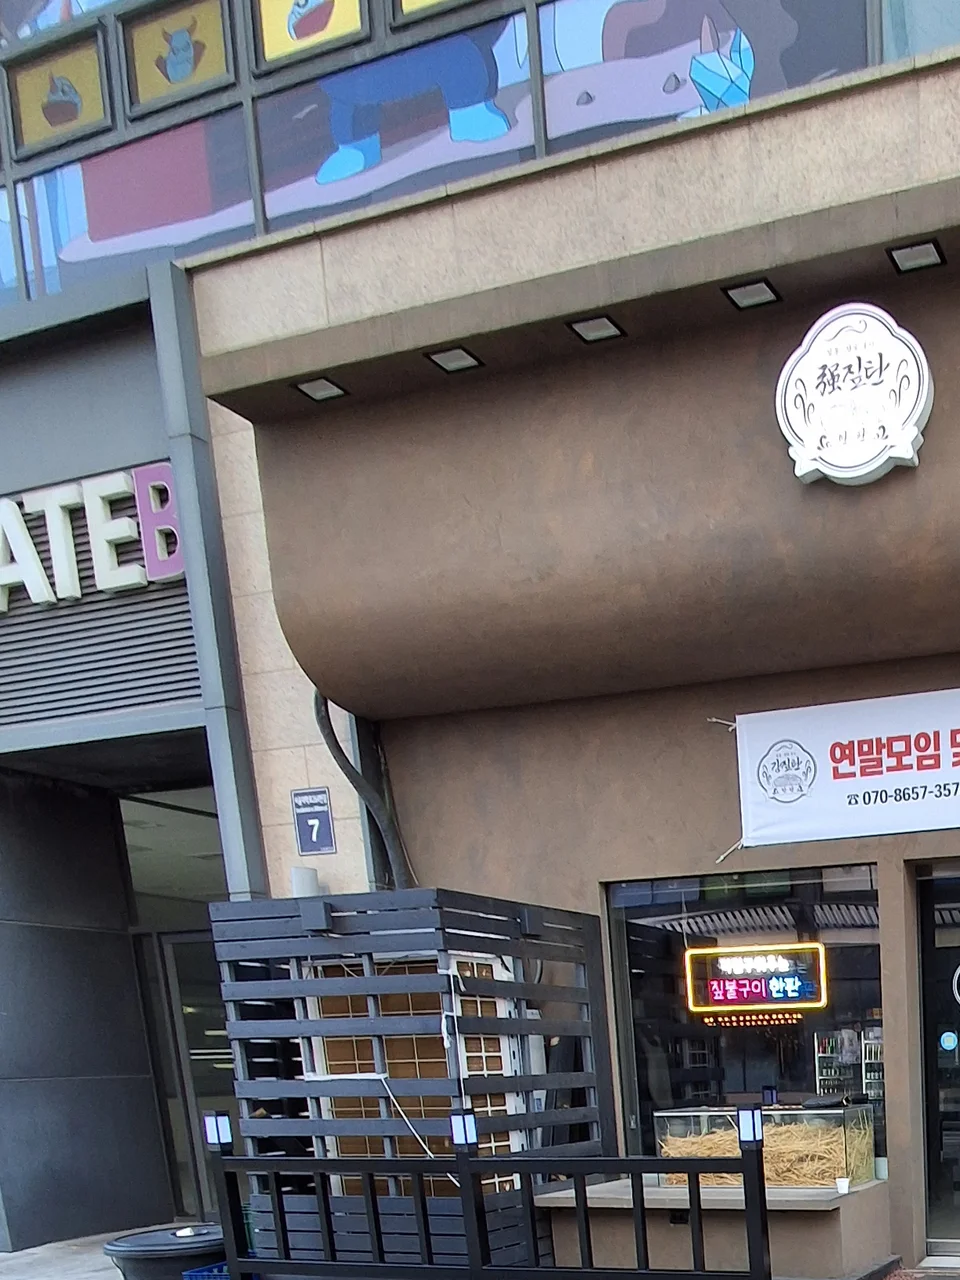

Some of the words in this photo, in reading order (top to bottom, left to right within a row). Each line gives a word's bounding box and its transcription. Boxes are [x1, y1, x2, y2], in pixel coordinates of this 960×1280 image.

[829, 730, 942, 780] 연말모임
[307, 818, 320, 842] 7
[768, 976, 802, 998] 한판
